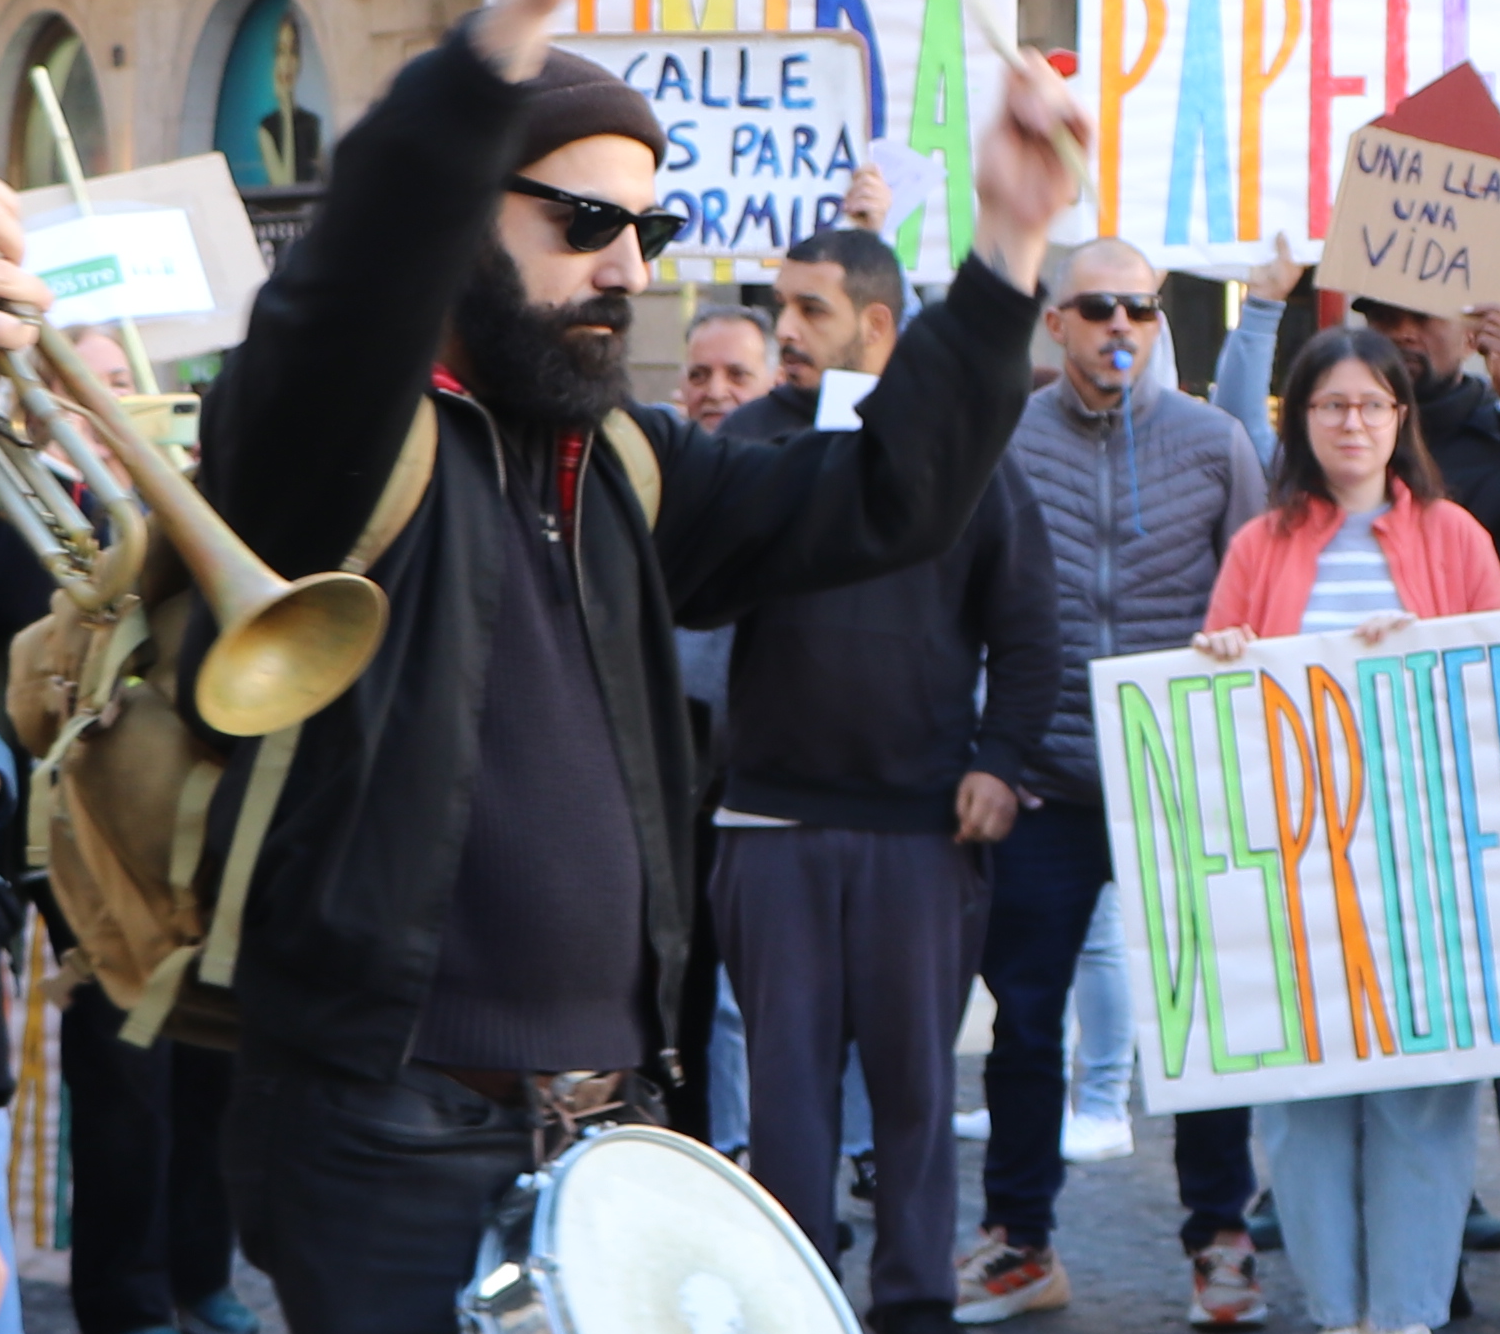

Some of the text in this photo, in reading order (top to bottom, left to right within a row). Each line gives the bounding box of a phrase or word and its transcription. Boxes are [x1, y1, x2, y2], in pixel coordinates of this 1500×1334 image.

[624, 47, 815, 110] CALLE
[666, 120, 860, 181] S PARA
[1356, 138, 1423, 184] UNA
[661, 187, 845, 249] ORMIR
[1392, 197, 1458, 233] UNA
